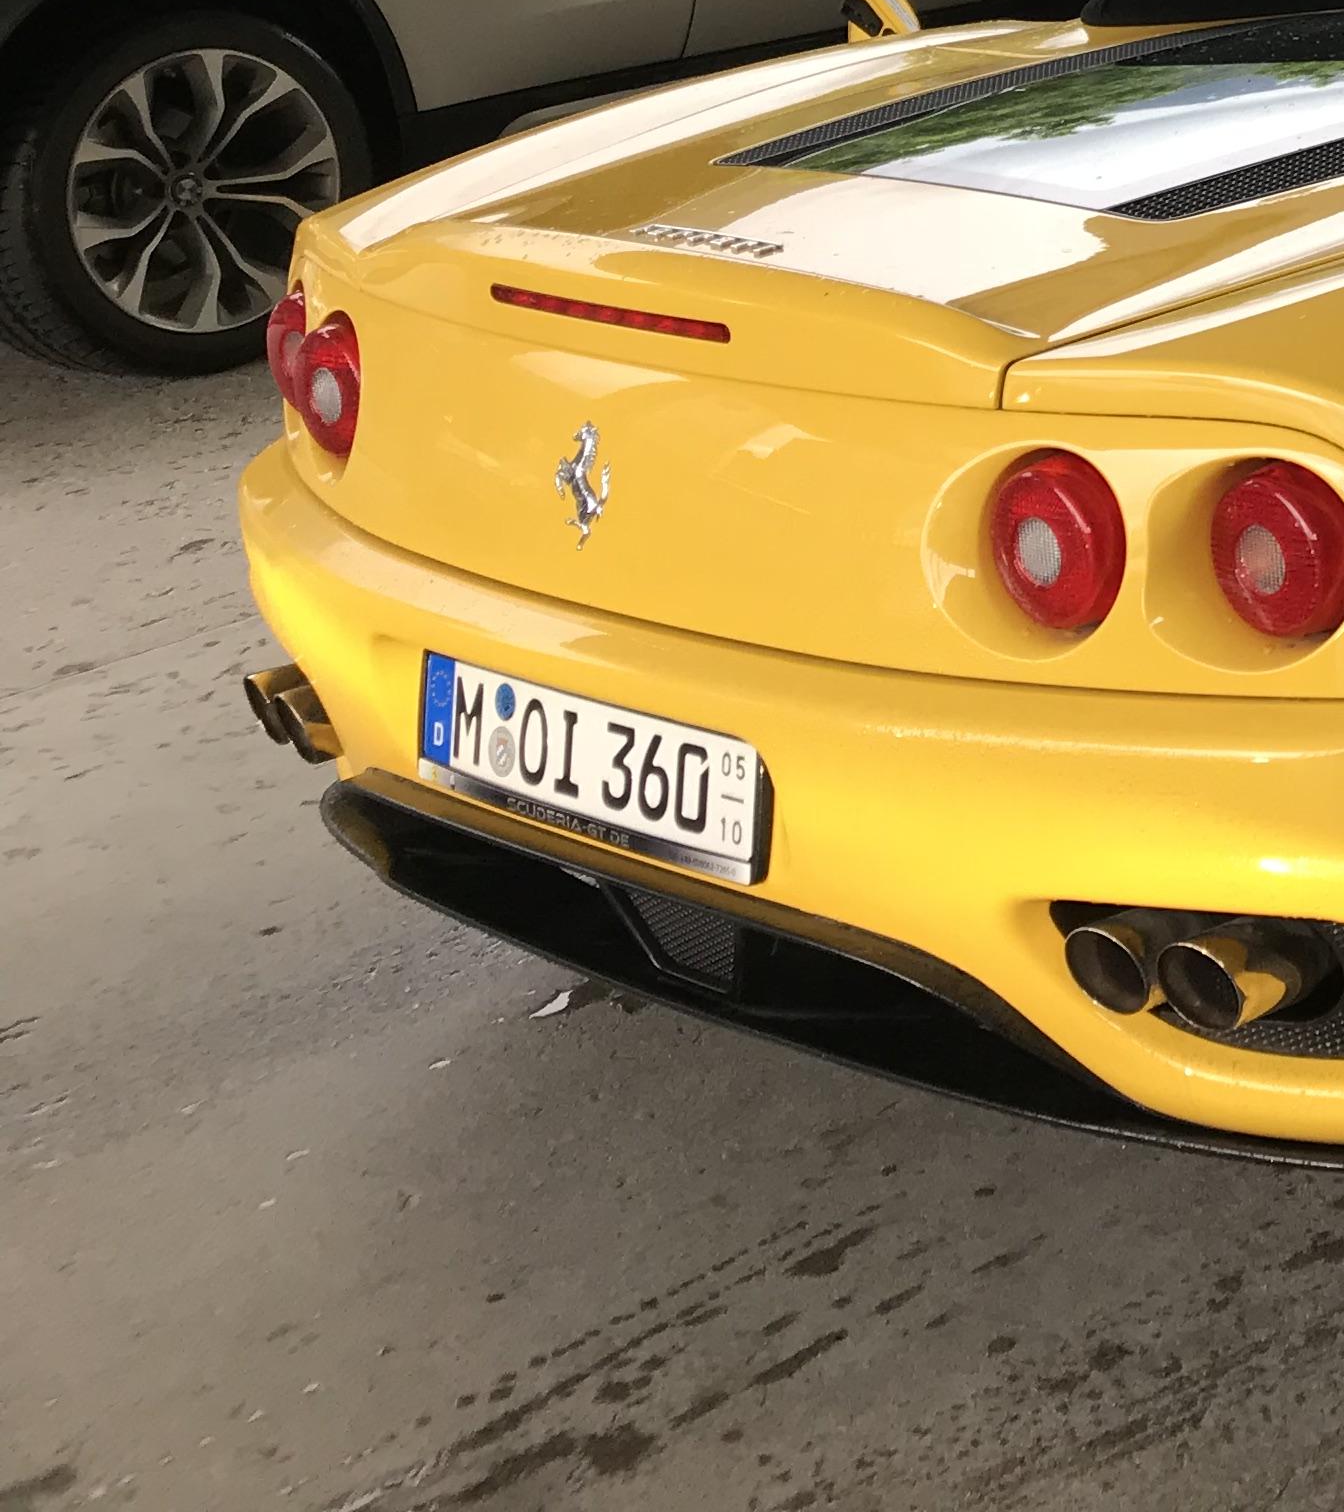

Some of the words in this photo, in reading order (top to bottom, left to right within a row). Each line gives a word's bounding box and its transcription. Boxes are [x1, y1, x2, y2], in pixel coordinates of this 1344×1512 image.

[433, 721, 443, 746] D
[453, 676, 484, 766] M
[519, 698, 579, 799] OI
[602, 722, 709, 834] 360
[721, 751, 746, 780] 05
[720, 817, 743, 845] 10
